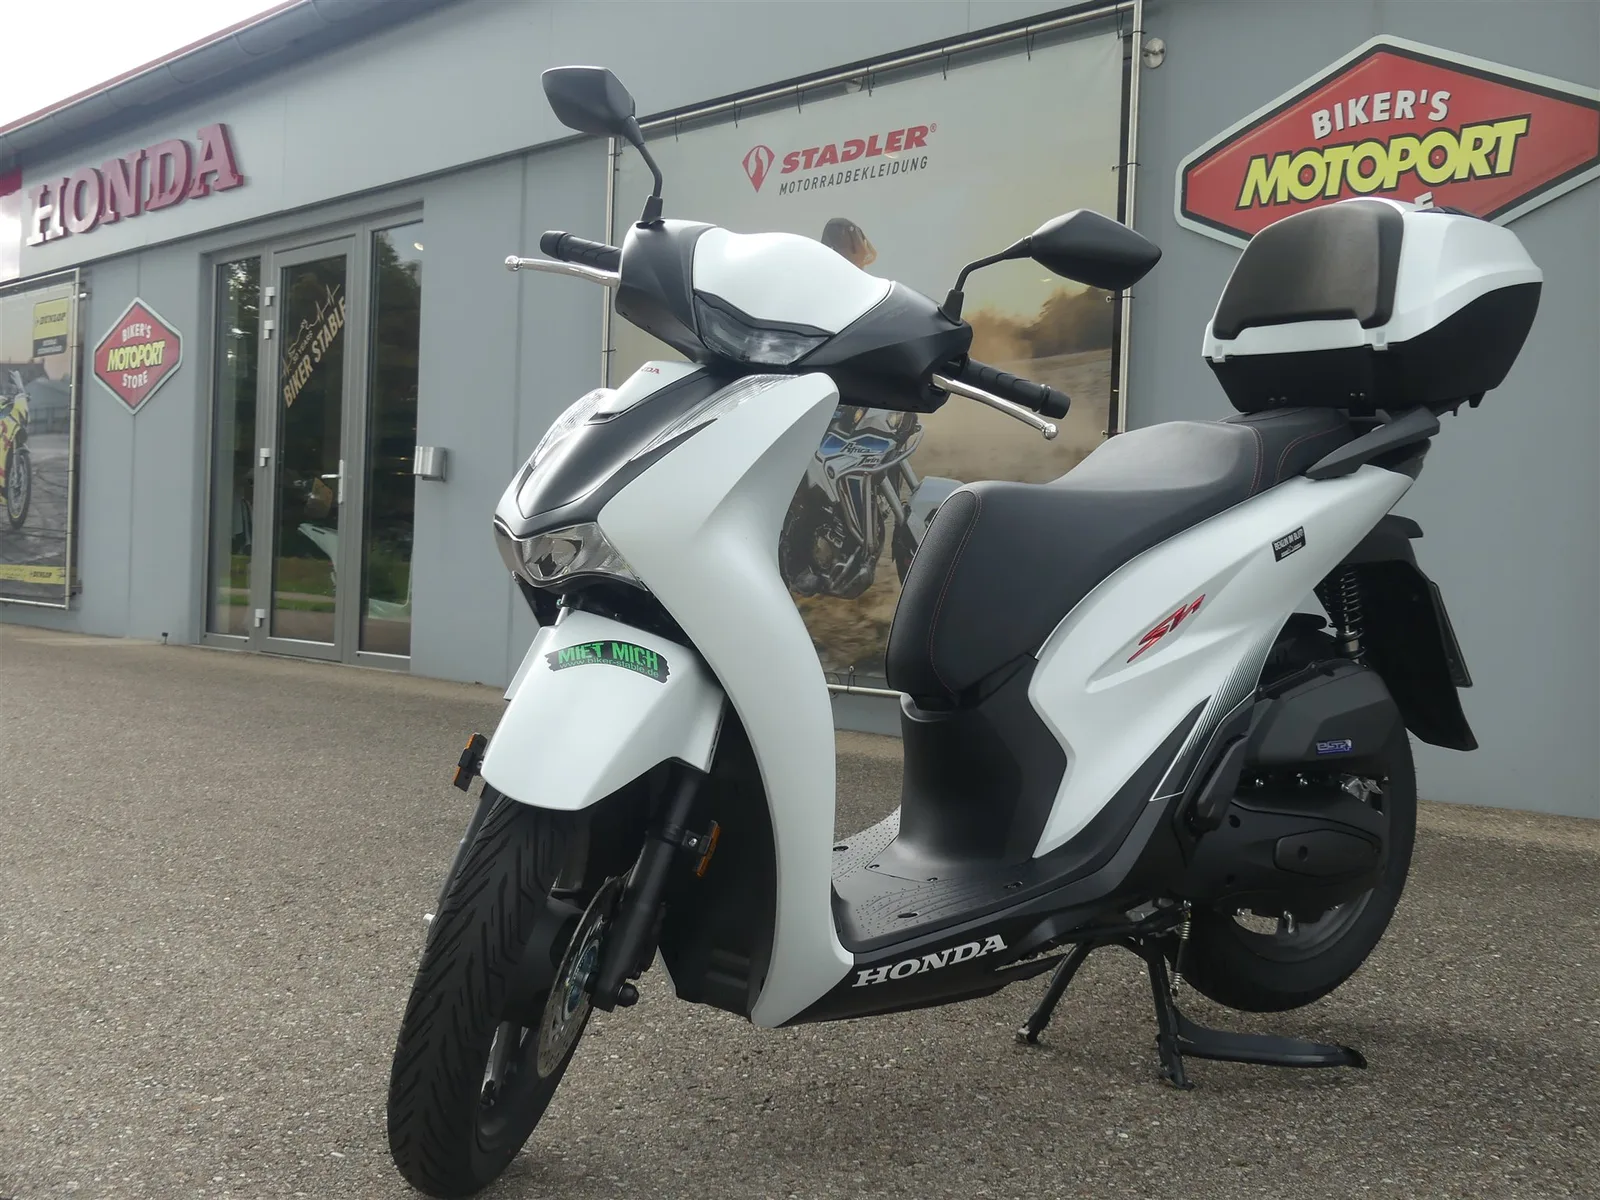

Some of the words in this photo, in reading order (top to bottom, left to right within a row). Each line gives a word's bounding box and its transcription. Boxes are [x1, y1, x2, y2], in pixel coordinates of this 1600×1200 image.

[1311, 88, 1451, 141] BIKER'S
[26, 122, 244, 247] HONDA
[779, 155, 929, 196] MOTORRADBEKLEIDUNG
[1236, 115, 1530, 209] MOTOPORT
[106, 340, 166, 372] MOTOPORT
[122, 323, 152, 342] BIKER'S
[122, 370, 148, 388] STORE
[283, 354, 314, 409] BIKER
[558, 642, 605, 664] MIET
[611, 642, 658, 671] MICH
[851, 934, 1009, 988] HONDA
